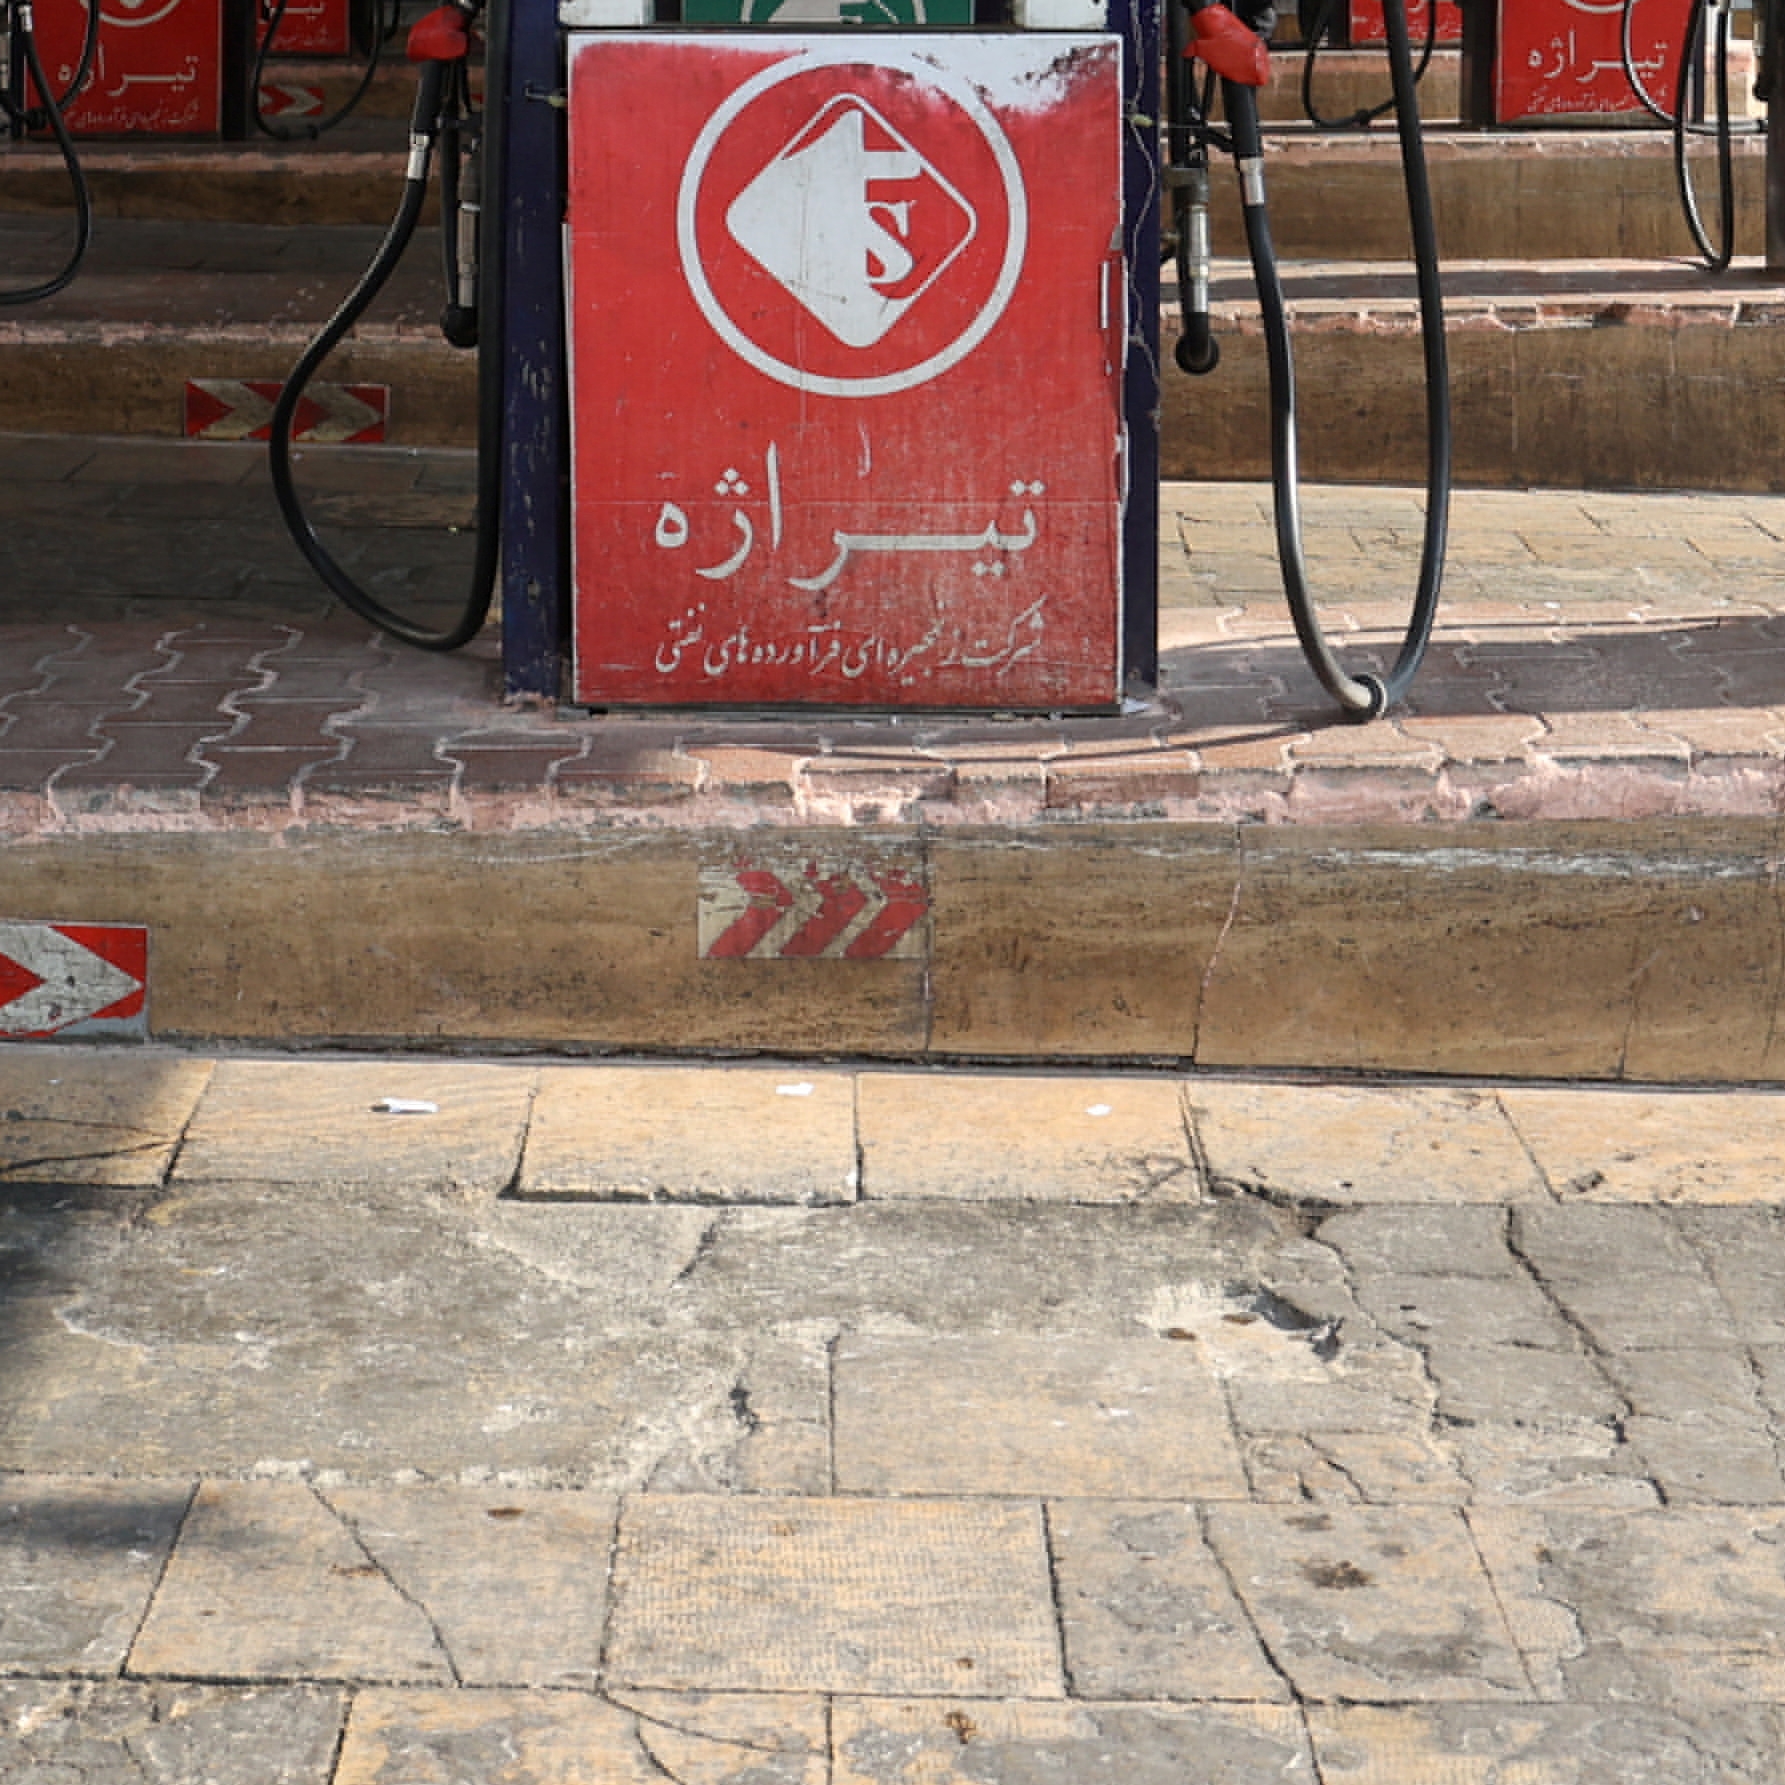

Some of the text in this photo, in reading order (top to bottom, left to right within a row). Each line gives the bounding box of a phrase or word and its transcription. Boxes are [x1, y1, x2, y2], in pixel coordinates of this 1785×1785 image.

[656, 441, 1046, 590] تیراژه
[655, 602, 706, 674] نفتی
[961, 594, 1049, 679] شرکت
